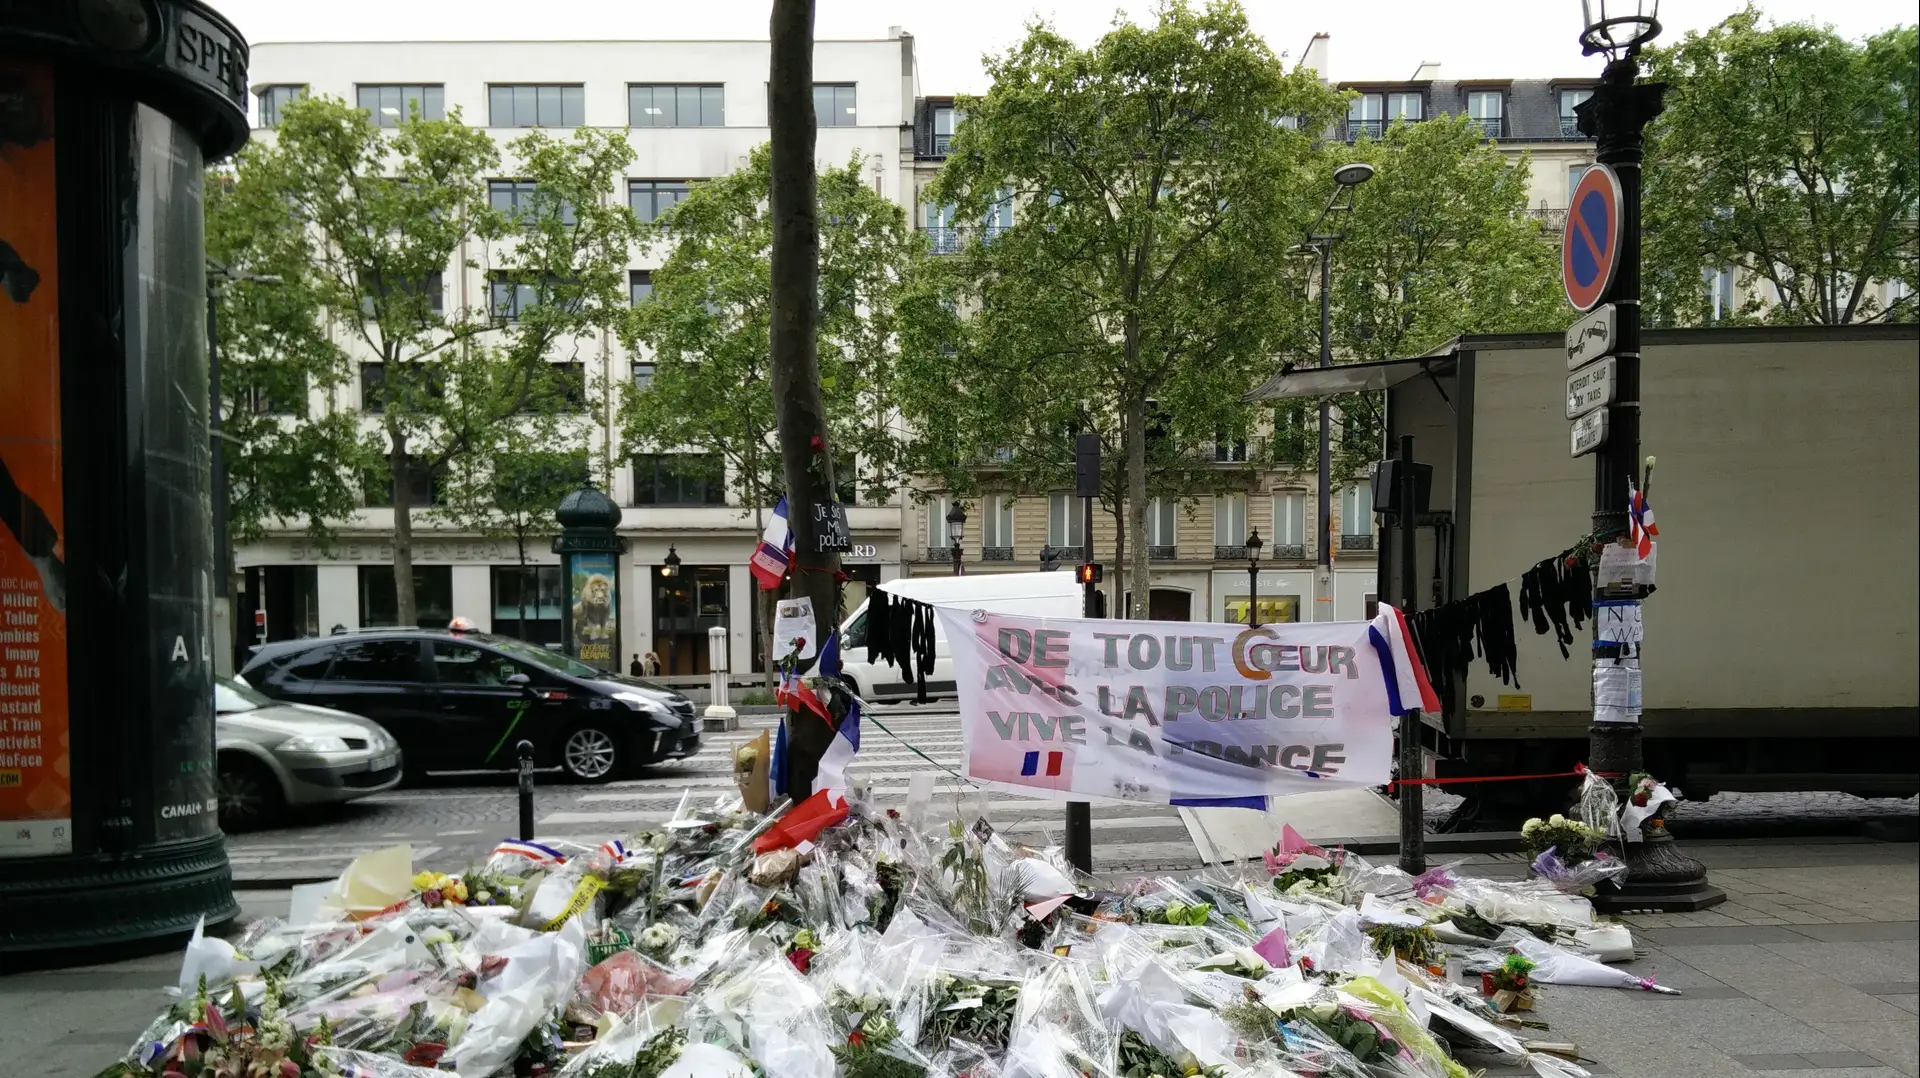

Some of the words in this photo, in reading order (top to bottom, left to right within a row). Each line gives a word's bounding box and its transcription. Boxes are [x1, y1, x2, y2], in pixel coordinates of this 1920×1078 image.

[1569, 375, 1590, 394] INTERDIT
[1593, 367, 1606, 383] SAUF
[1587, 387, 1601, 403] TAXIS
[814, 503, 828, 521] JE
[1234, 579, 1273, 587] LACSTE
[3, 592, 39, 607] Miller
[5, 610, 39, 625] Tailor
[6, 647, 39, 663] Imany
[998, 628, 1071, 668] DE
[1093, 631, 1224, 673] TOUT
[16, 664, 40, 678] Airs
[1097, 685, 1160, 728] LA
[1164, 684, 1335, 723] POLICE
[11, 718, 41, 731] Train
[986, 711, 1086, 746] VIVE
[161, 802, 202, 819] CANAL+
